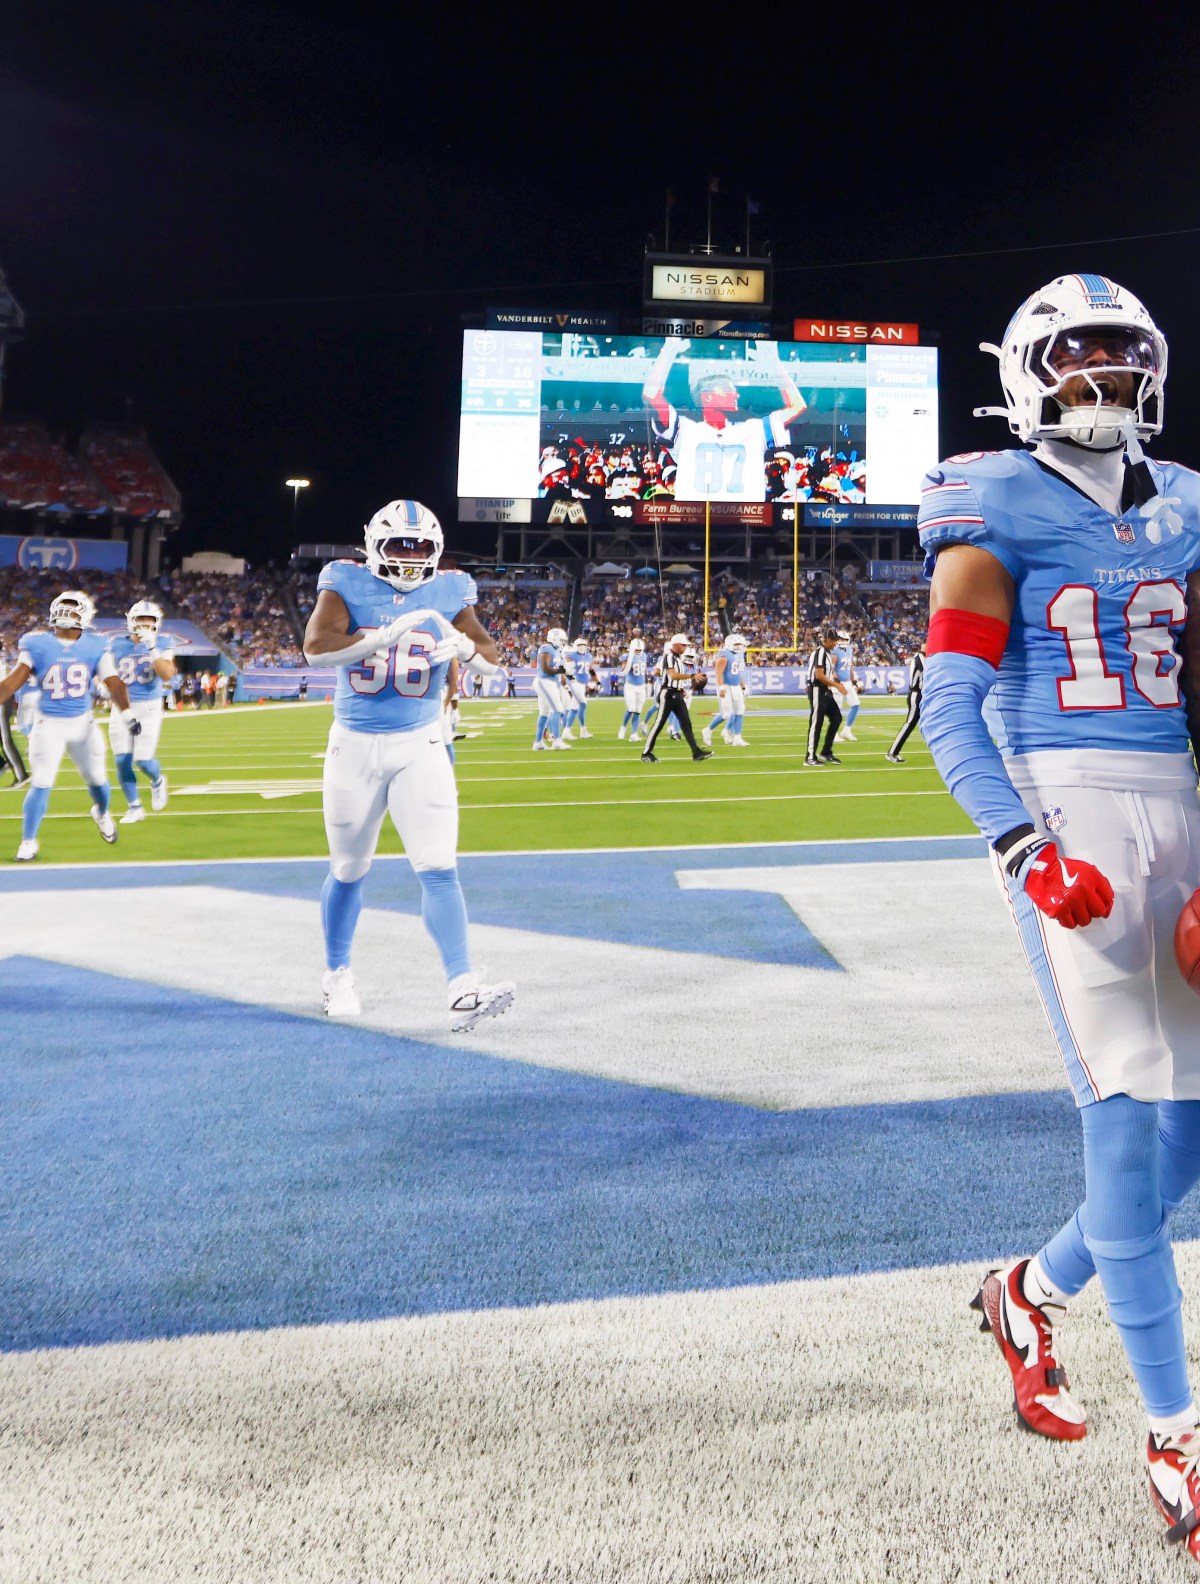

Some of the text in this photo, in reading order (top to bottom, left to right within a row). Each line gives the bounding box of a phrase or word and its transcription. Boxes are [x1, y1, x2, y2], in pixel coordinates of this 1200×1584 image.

[667, 273, 749, 286] NISSAN
[680, 286, 736, 296] STADIUM
[1088, 302, 1123, 310] TITANS
[497, 314, 553, 324] VANDERBILT
[570, 317, 606, 326] HEALTH
[643, 319, 704, 336] Pinnacle
[718, 329, 770, 339] TitansBanking.com
[810, 324, 903, 340] NISSAN
[694, 442, 746, 495] 87
[642, 504, 764, 515] Farm Bureau NSURANCE
[821, 507, 849, 524] Kroger
[1095, 566, 1162, 583] TITANS
[1046, 578, 1188, 712] 16
[349, 626, 438, 697] 36
[118, 656, 154, 685] 83
[42, 663, 89, 699] 49
